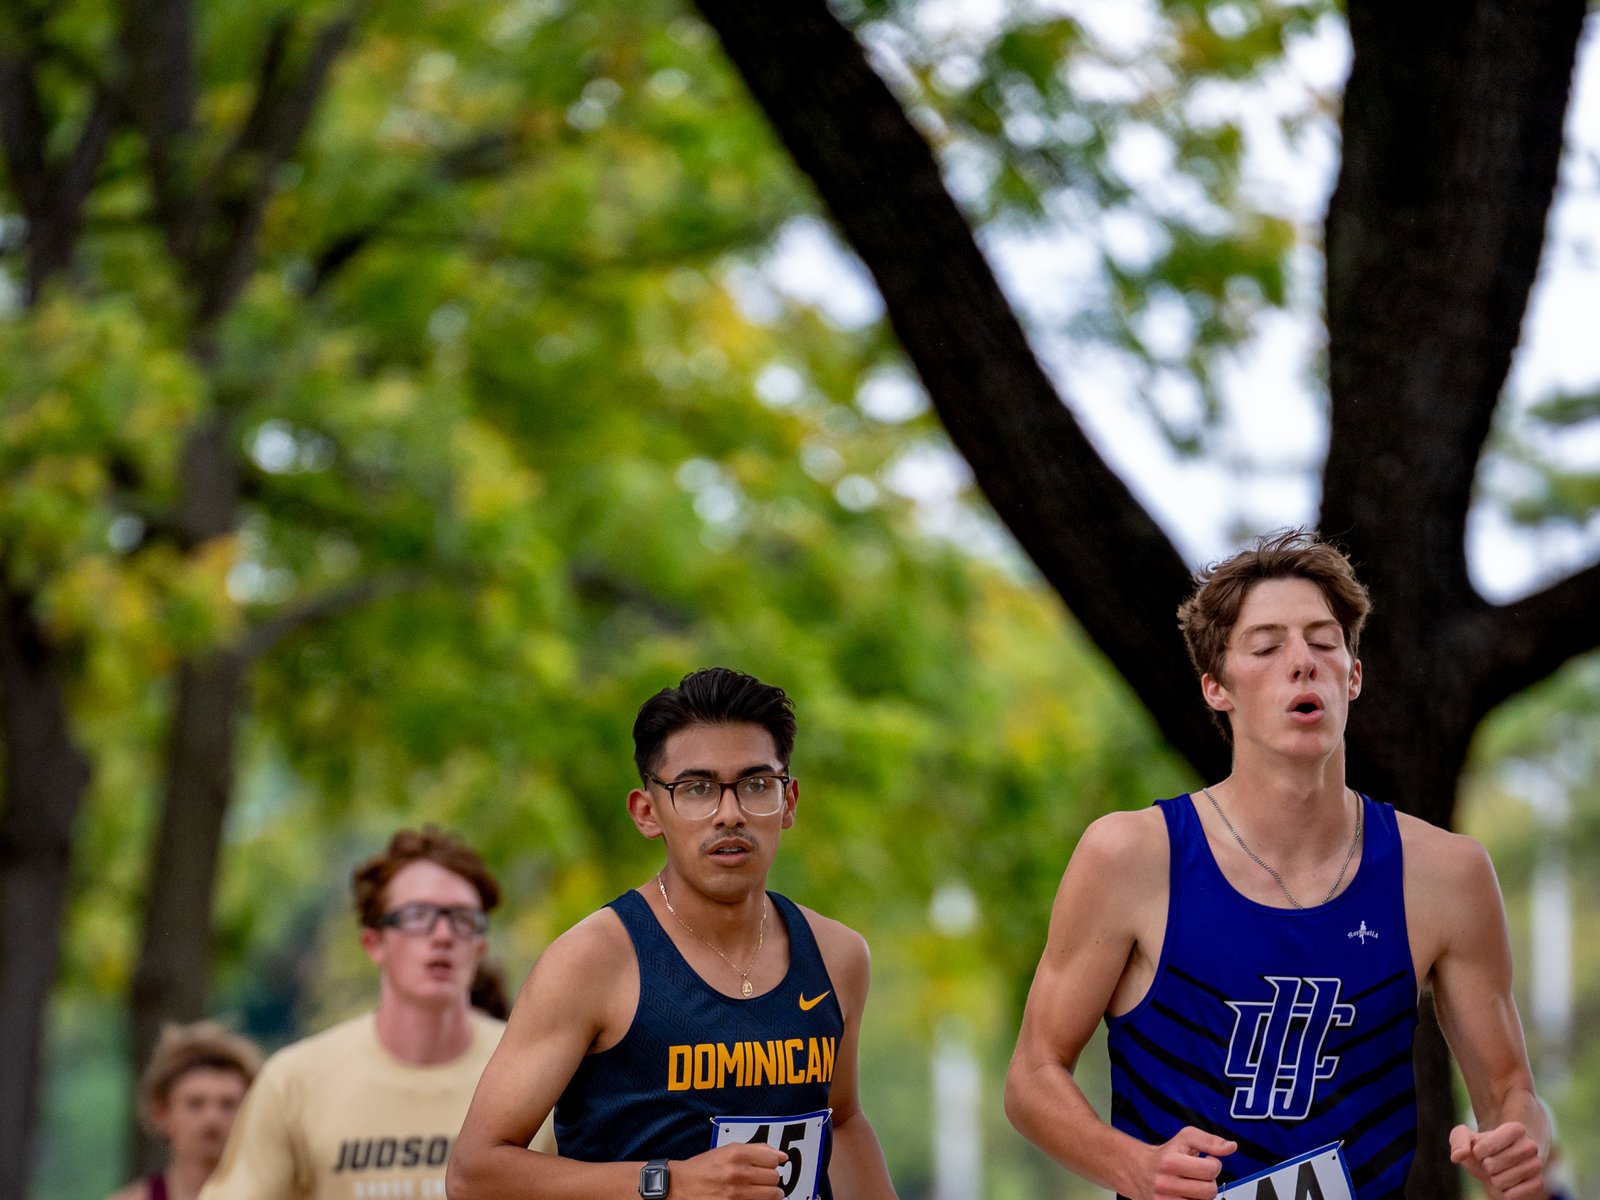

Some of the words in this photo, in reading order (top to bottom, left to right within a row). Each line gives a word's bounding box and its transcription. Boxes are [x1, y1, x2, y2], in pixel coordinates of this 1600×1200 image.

[667, 1036, 836, 1092] DOMINICAN
[333, 1135, 451, 1173] JUDSO
[744, 1122, 807, 1198] 5
